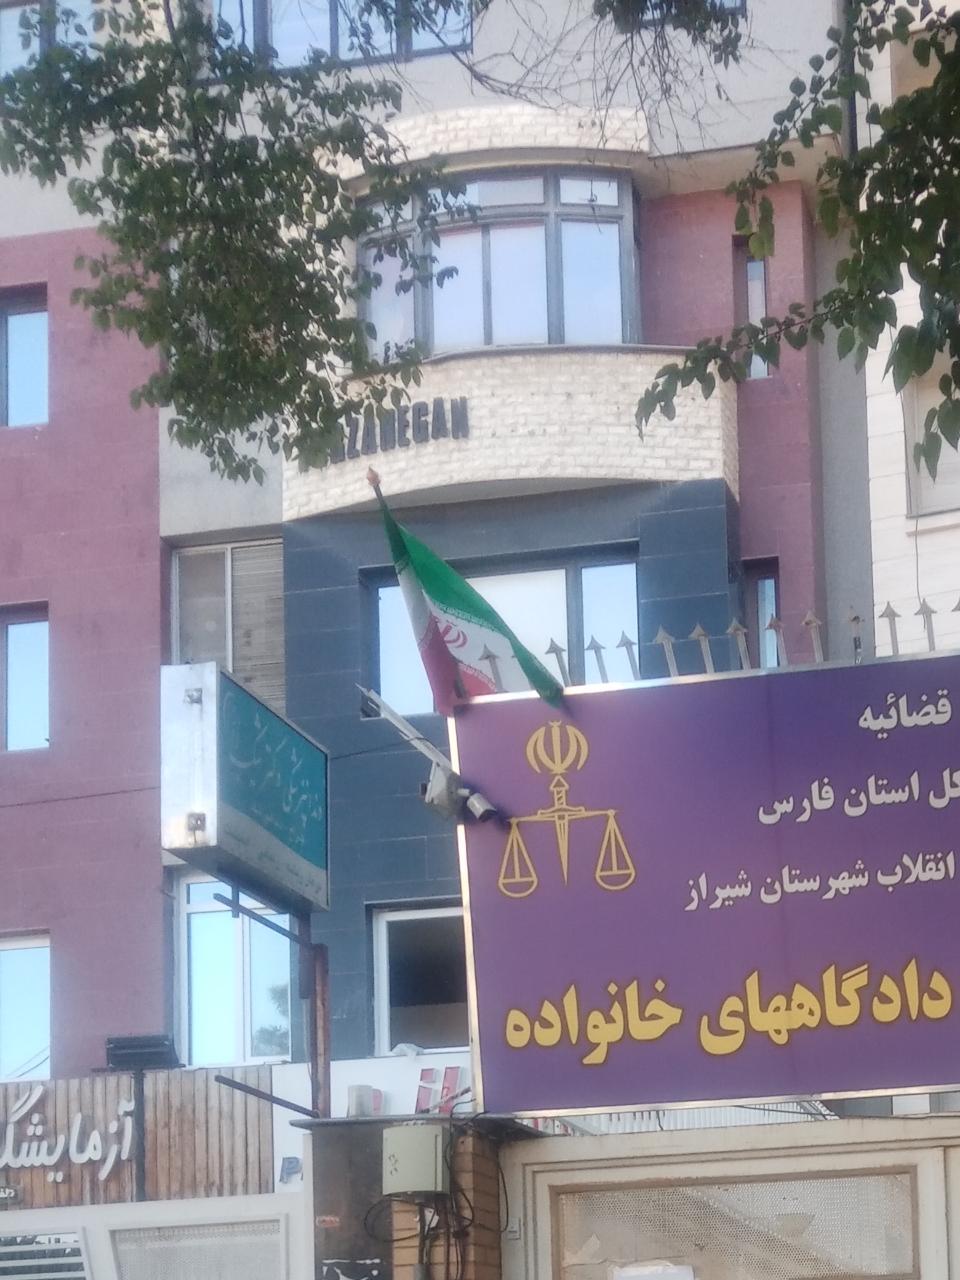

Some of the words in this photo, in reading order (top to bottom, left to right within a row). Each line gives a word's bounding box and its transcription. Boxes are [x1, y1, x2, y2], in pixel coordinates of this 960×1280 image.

[858, 689, 953, 740] قضائیه
[757, 777, 836, 827] فارس
[844, 771, 921, 818] استان
[684, 870, 754, 913] شیراز
[760, 860, 871, 906] شهرستان
[877, 851, 957, 894] انقلاب
[505, 978, 685, 1067] خانواده
[699, 957, 954, 1057] دادگاههای
